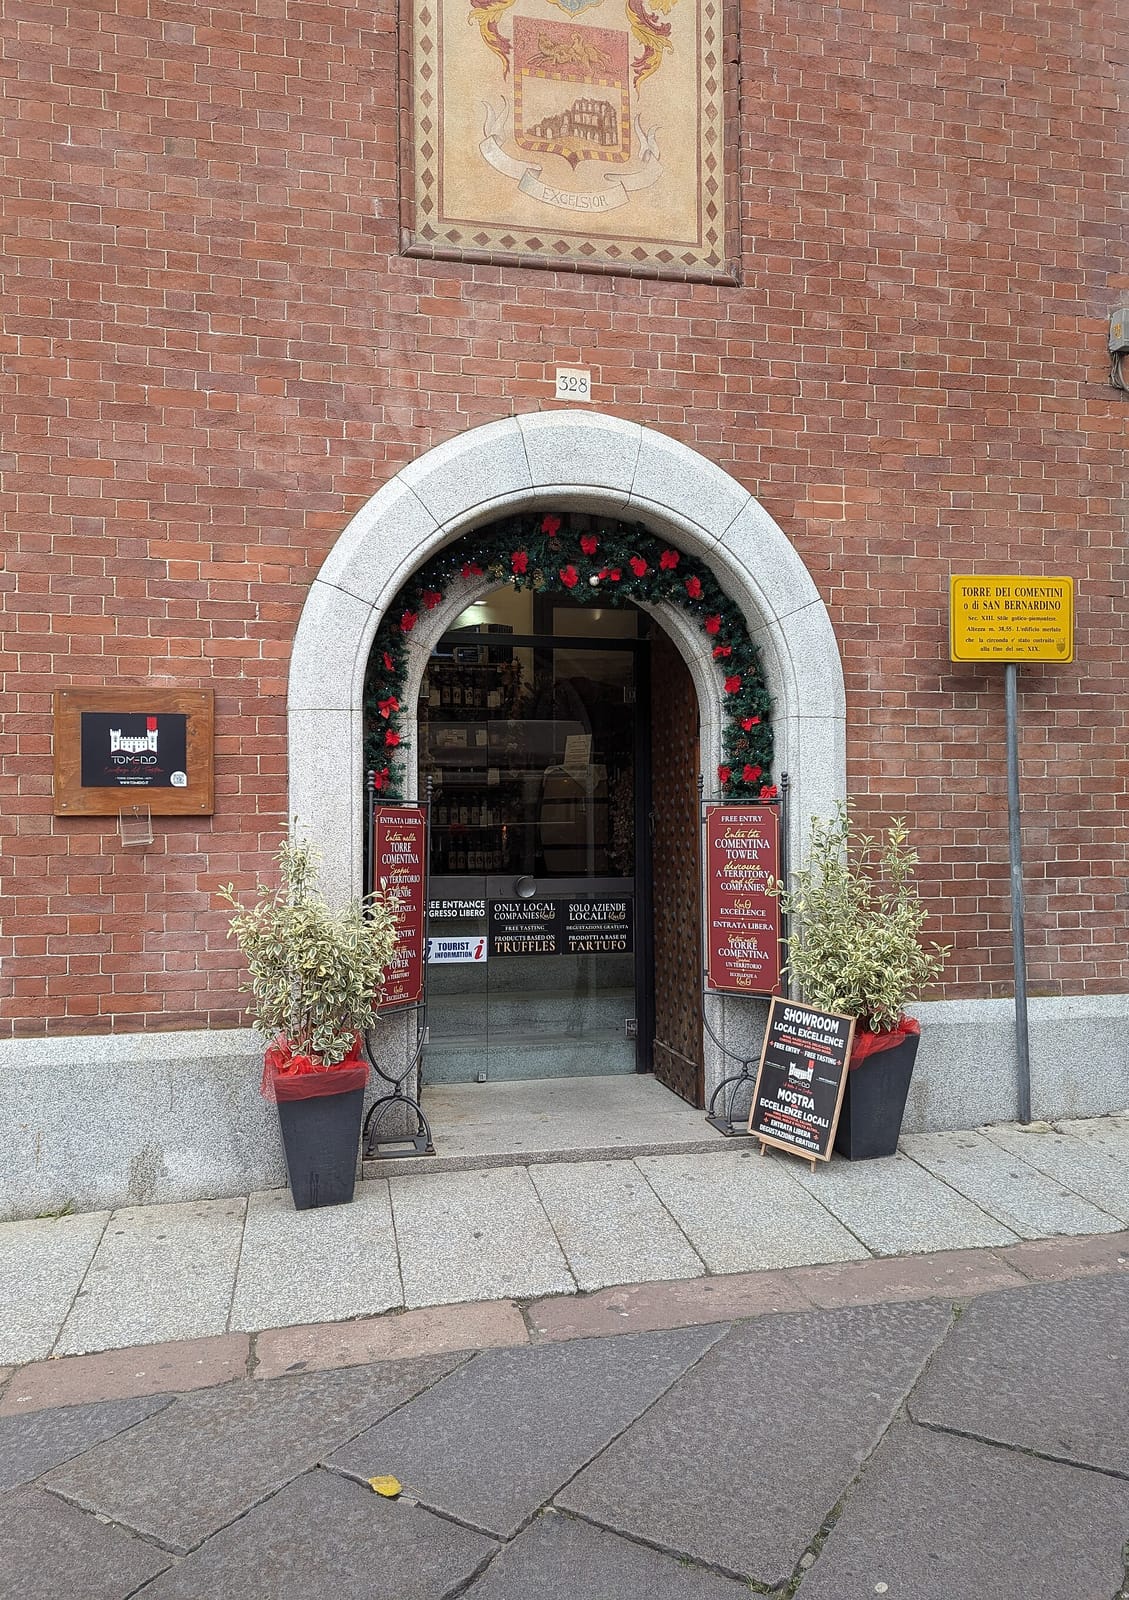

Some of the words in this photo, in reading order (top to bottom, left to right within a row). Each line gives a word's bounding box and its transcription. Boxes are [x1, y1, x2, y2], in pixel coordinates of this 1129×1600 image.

[542, 187, 608, 208] EXCELSIOR
[558, 376, 588, 393] 328
[962, 587, 991, 597] TORRE
[996, 588, 1010, 597] DEI
[1014, 588, 1062, 597] COMENTINI
[972, 601, 979, 609] di
[983, 601, 1000, 610] SAN
[1004, 601, 1060, 610] BERNARDINO
[390, 842, 411, 852] TORRE
[715, 839, 770, 848] COMENTINA
[382, 854, 419, 864] COMENTINA
[726, 850, 759, 859] TOWER
[723, 870, 769, 878] TERRITORY
[389, 875, 420, 884] TERRITORIO
[721, 883, 765, 892] COMPANIES
[442, 900, 485, 908] ENTRANCE
[494, 903, 520, 912] ONLY
[524, 902, 556, 911] LOCAL
[569, 903, 590, 912] SOLO
[592, 903, 626, 911] AZIENDE
[494, 912, 539, 920] COMPANIES
[570, 912, 607, 920] LOCALI
[720, 908, 766, 916] EXCELLENCE
[398, 929, 416, 938] ENTRY
[438, 942, 469, 951] TOURIST
[495, 940, 556, 952] TRUFFLES
[569, 940, 626, 951] TARTUFO
[730, 941, 758, 950] TORRE
[718, 948, 769, 959] COMENTINA
[390, 960, 409, 970] TOWER
[784, 1008, 839, 1034] SHOWROOM
[774, 1022, 797, 1035] LOCAL
[798, 1028, 844, 1048] EXCELLENCE
[774, 1042, 785, 1050] FREE
[785, 1045, 800, 1054] ENTRY
[804, 1051, 816, 1059] FREE
[817, 1054, 836, 1065] TASTING
[777, 1088, 814, 1110] MOSTRA
[760, 1098, 802, 1119] ECCELLENZE
[803, 1112, 829, 1128] LOCALI
[770, 1119, 792, 1132] ENTRATA
[793, 1127, 811, 1139] LIBERA
[760, 1124, 795, 1142] DEGUSTAZIONE
[796, 1136, 820, 1151] GRATUITA
